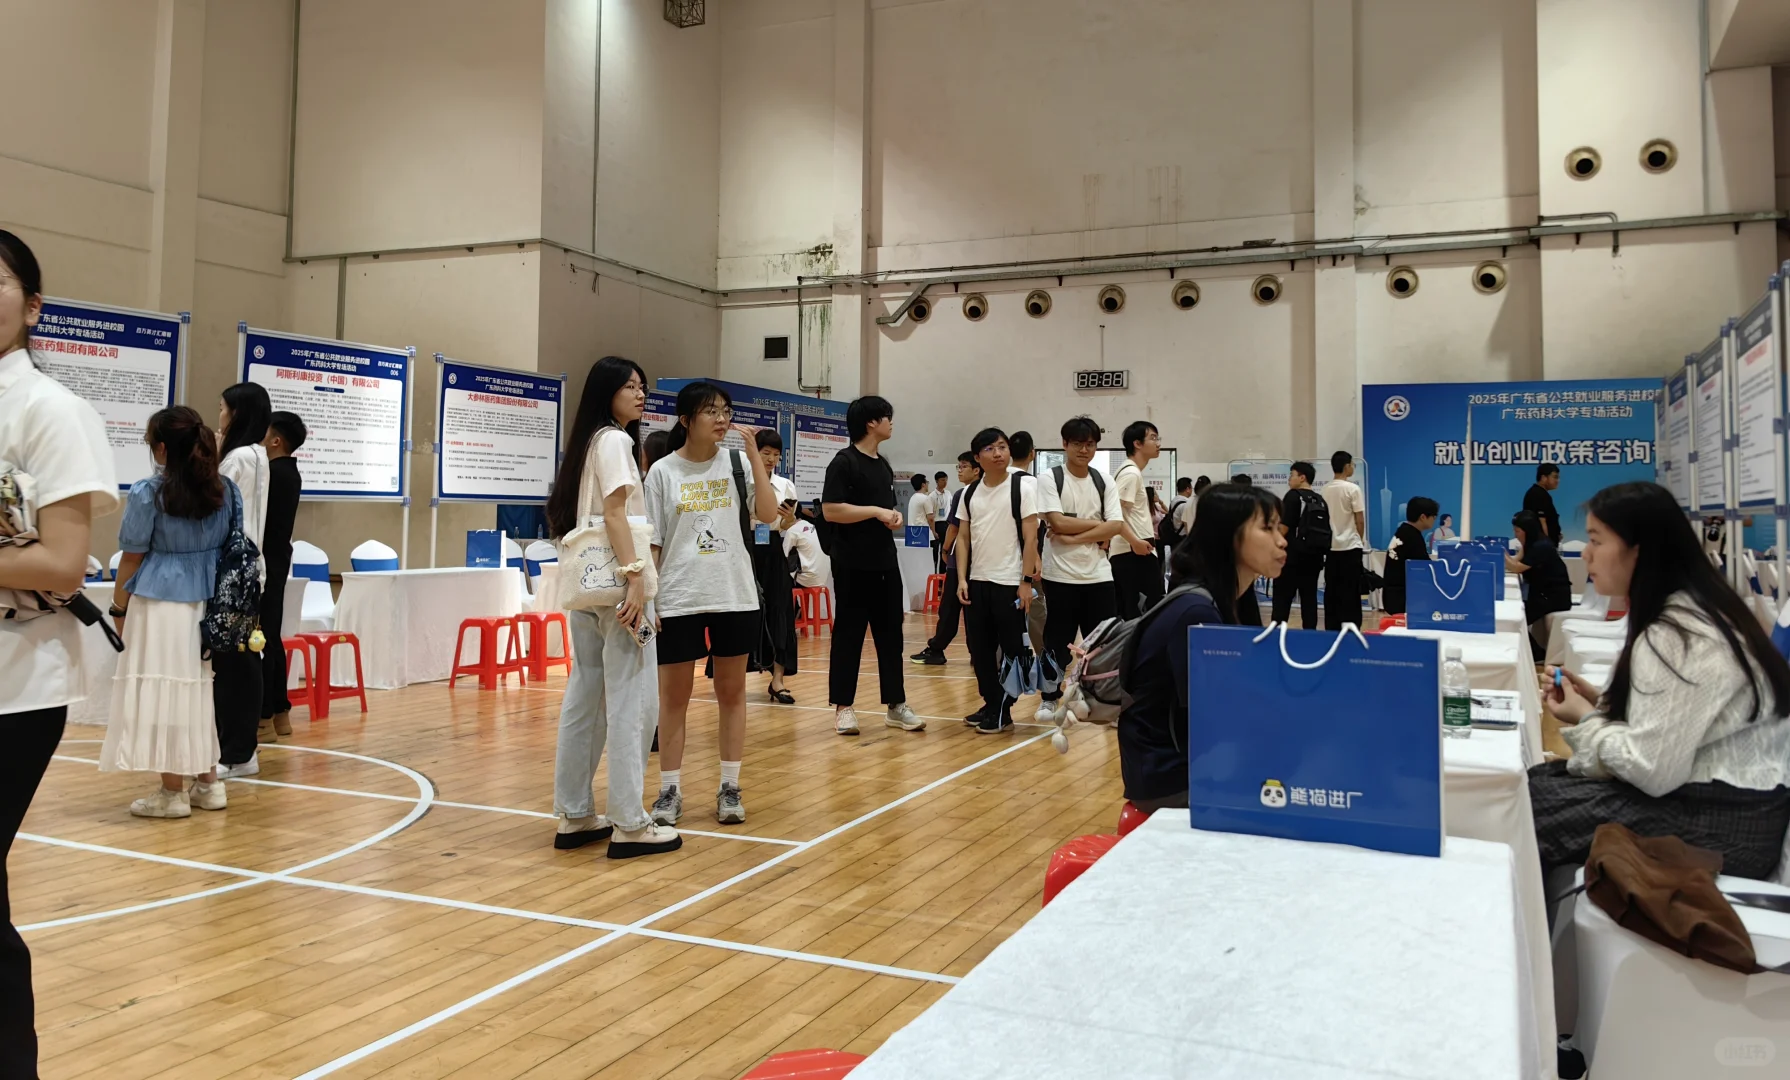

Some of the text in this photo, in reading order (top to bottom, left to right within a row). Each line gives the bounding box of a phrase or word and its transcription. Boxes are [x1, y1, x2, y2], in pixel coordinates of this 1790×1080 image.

[30, 323, 105, 340] 东药科大学专场活动
[154, 338, 166, 346] 007
[290, 349, 371, 366] 2025年广东省公共就业服务进校园
[304, 359, 357, 372] 广东药科大学专场活动
[467, 392, 539, 408] 大参林医药集团股份有限公司
[1501, 405, 1633, 420] 广东药科大学专场活动
[1434, 441, 1656, 465] 就业创业政策咨询
[680, 477, 729, 492] FOR THE
[681, 487, 728, 502] LOVE OF
[675, 496, 732, 515] PEANUTS!
[1290, 786, 1363, 809] 熊猫进厂
